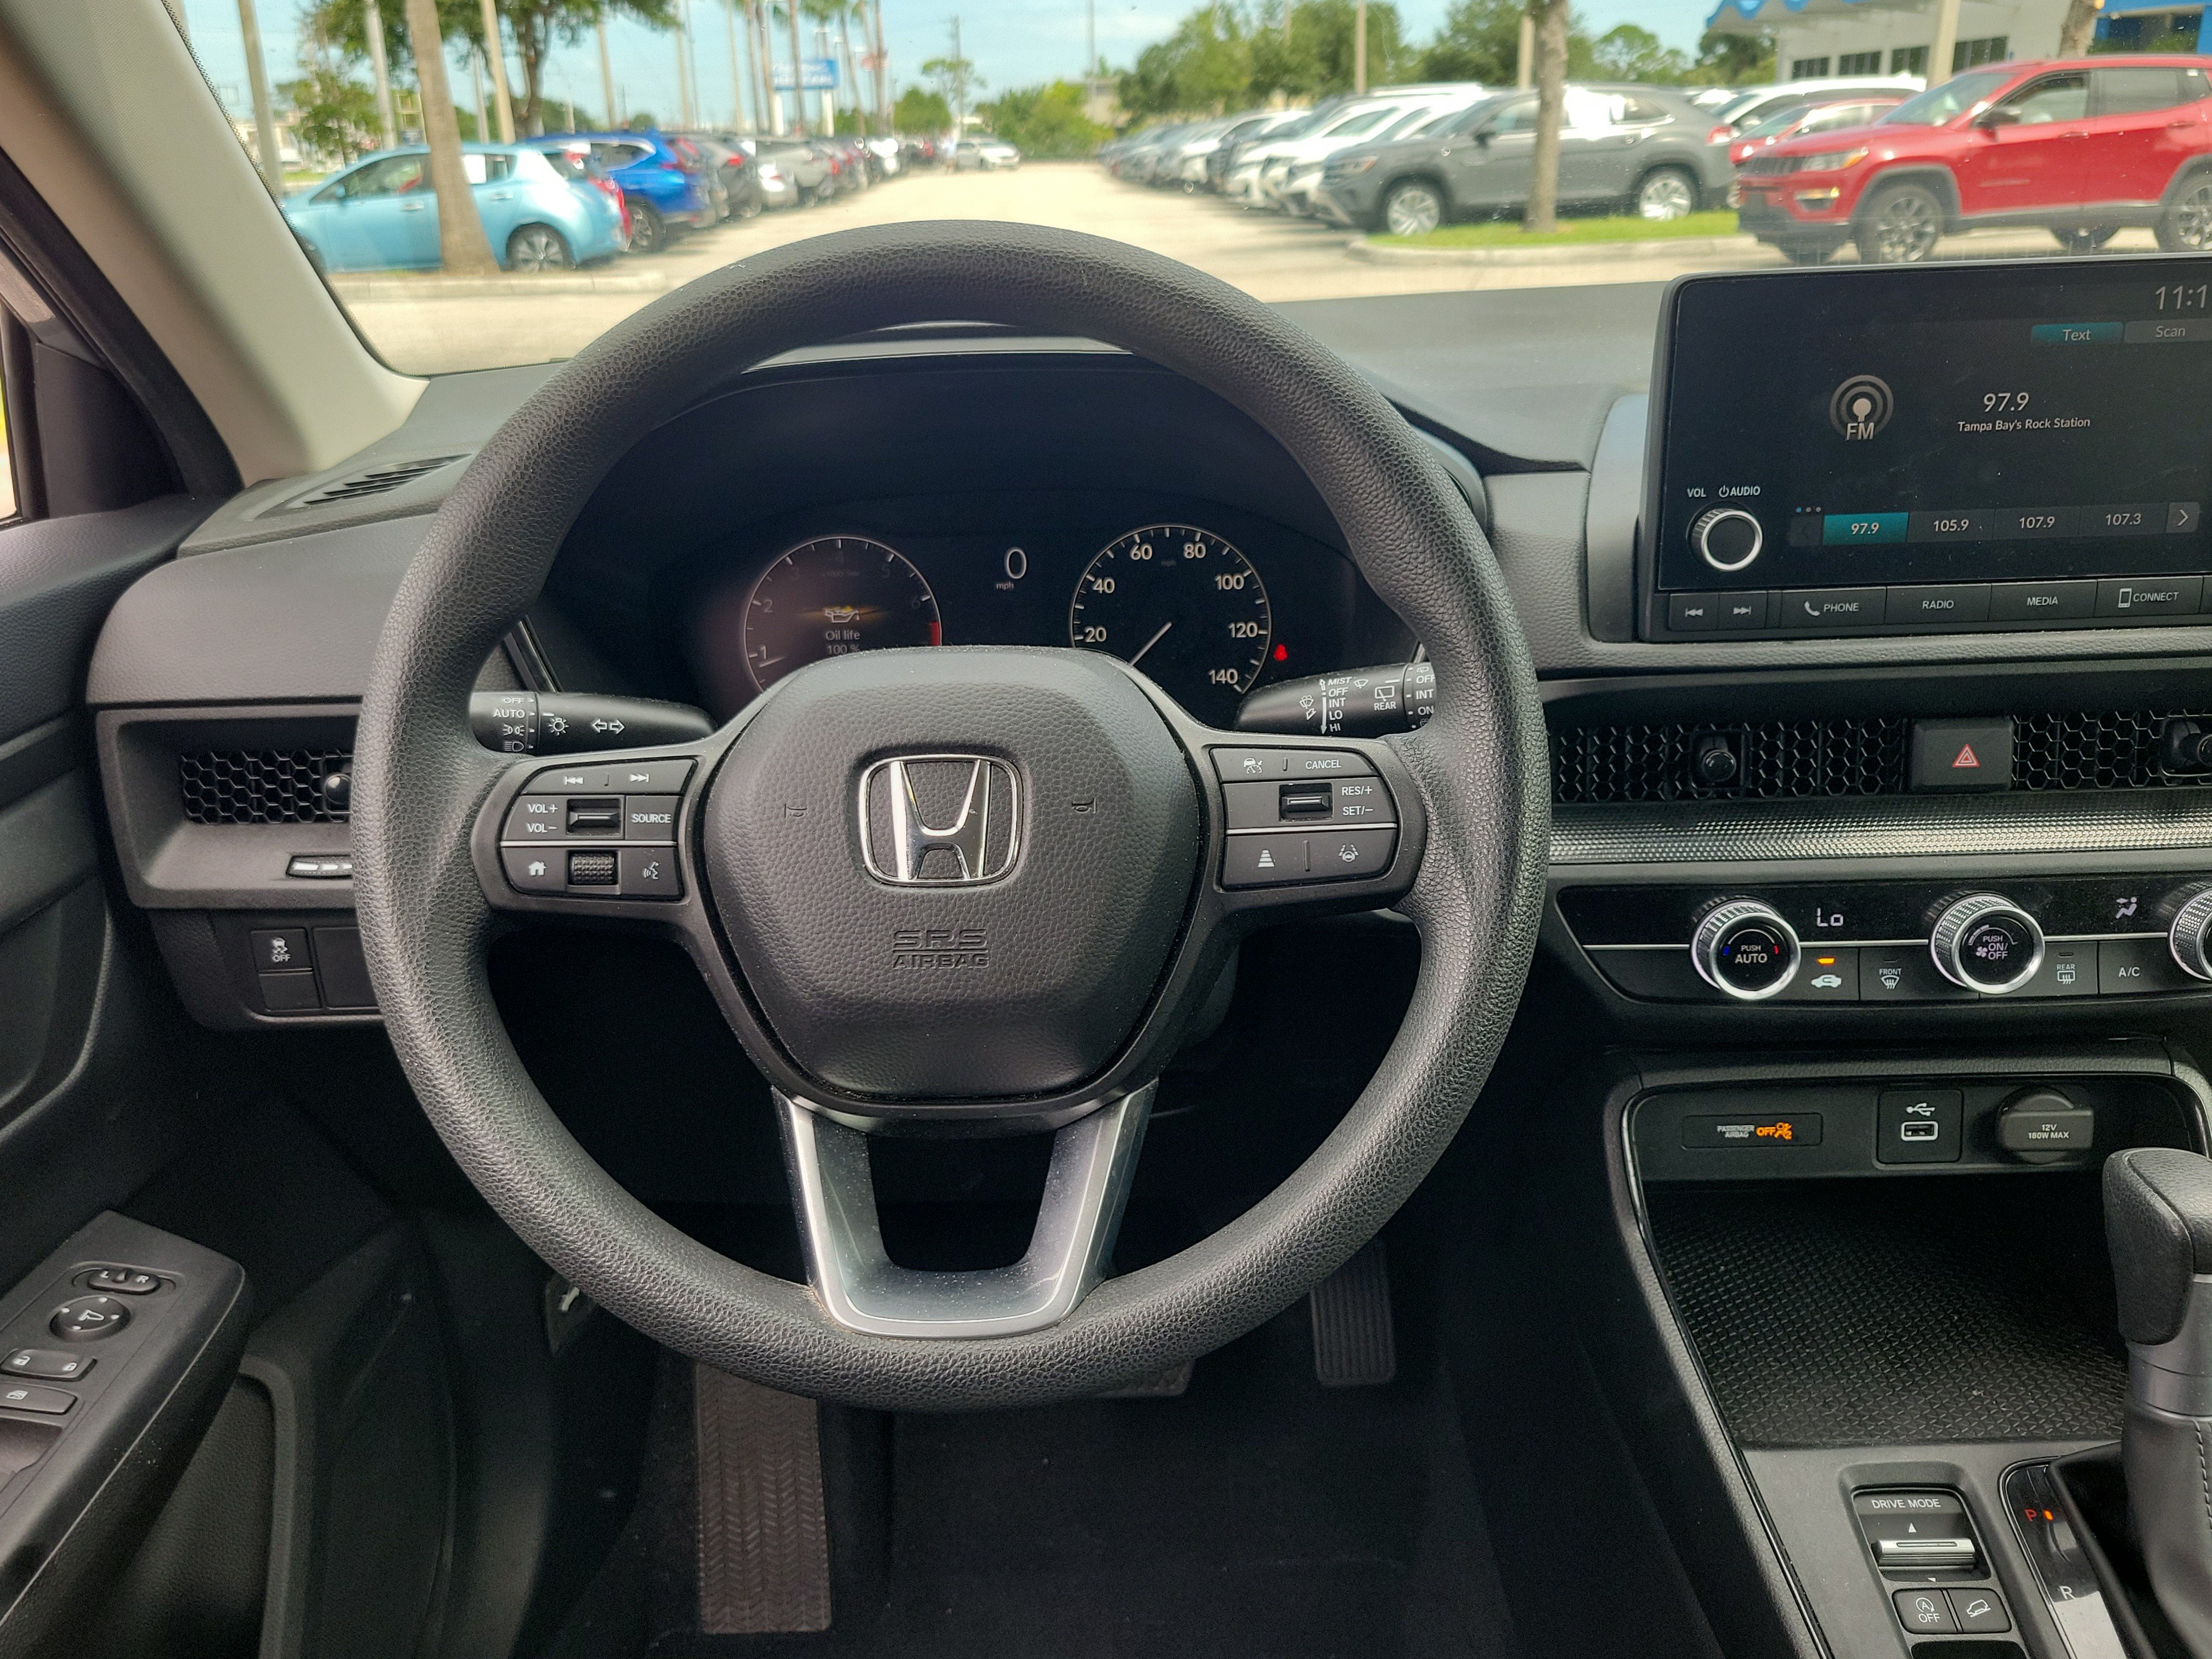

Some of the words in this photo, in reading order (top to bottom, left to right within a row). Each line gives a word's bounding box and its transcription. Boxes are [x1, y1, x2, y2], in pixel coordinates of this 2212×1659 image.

[2155, 284, 2208, 310] 11:1
[2062, 329, 2092, 341] Text
[2155, 326, 2186, 337] Scan
[1983, 392, 2030, 412] 97.9
[1957, 421, 1993, 432] Tampa
[1995, 420, 2022, 432] Bay's
[2025, 419, 2051, 430] Rock
[2053, 417, 2091, 428] Station
[1846, 422, 1874, 440] FM
[1687, 488, 1707, 498] VOL
[1730, 486, 1761, 496] AUDIO
[2019, 516, 2056, 528] 107.9
[2105, 512, 2142, 525] 107.3
[1851, 523, 1880, 534] 97.9
[1933, 518, 1970, 531] 105.9
[1130, 545, 1152, 560] 60
[1184, 543, 1206, 558] 80
[1006, 548, 1027, 579] 0
[996, 582, 1014, 591] mph
[1092, 578, 1115, 594] 40
[1214, 574, 1244, 590] 100
[2027, 596, 2059, 607] MEDIA
[2133, 592, 2179, 602] CONNECT
[762, 598, 774, 613] 2
[1823, 602, 1859, 613] PHONE
[1921, 599, 1954, 610] RADIO
[1084, 627, 1107, 642] 20
[1228, 622, 1259, 637] 120
[825, 631, 842, 641] Oil
[844, 630, 860, 641] life
[760, 645, 767, 659] 1
[827, 645, 848, 655] 100
[1208, 669, 1238, 685] 140
[1328, 676, 1353, 686] MIST
[1416, 674, 1435, 684] OFF
[1328, 687, 1348, 697] OFF
[1416, 689, 1434, 699] INT
[1329, 697, 1346, 708] INT
[1374, 702, 1397, 711] REAR
[493, 709, 525, 719] AUTO
[1329, 710, 1343, 720] LO
[1418, 706, 1435, 716] ON
[1329, 723, 1341, 732] HI
[1305, 759, 1342, 770] CANCEL
[1341, 785, 1373, 797] RES/+
[527, 803, 558, 814] VOL+
[1342, 805, 1374, 816] SET/-
[631, 812, 672, 823] SOURCE
[1816, 908, 1844, 927] Lo
[894, 929, 987, 950] SRS
[1988, 943, 2008, 951] ON/
[272, 953, 290, 962] OFF
[893, 953, 989, 969] AIRBAG
[1735, 953, 1767, 963] AUTO
[1988, 951, 2008, 960] OFF
[2118, 967, 2140, 978] A/C
[1756, 1126, 1776, 1136] OFF
[136, 1275, 149, 1283] R
[1871, 1499, 1906, 1509] DRIVE
[1908, 1498, 1941, 1508] MODE
[2024, 1508, 2038, 1522] P
[2059, 1585, 2075, 1600] R
[1918, 1613, 1940, 1623] OFF
